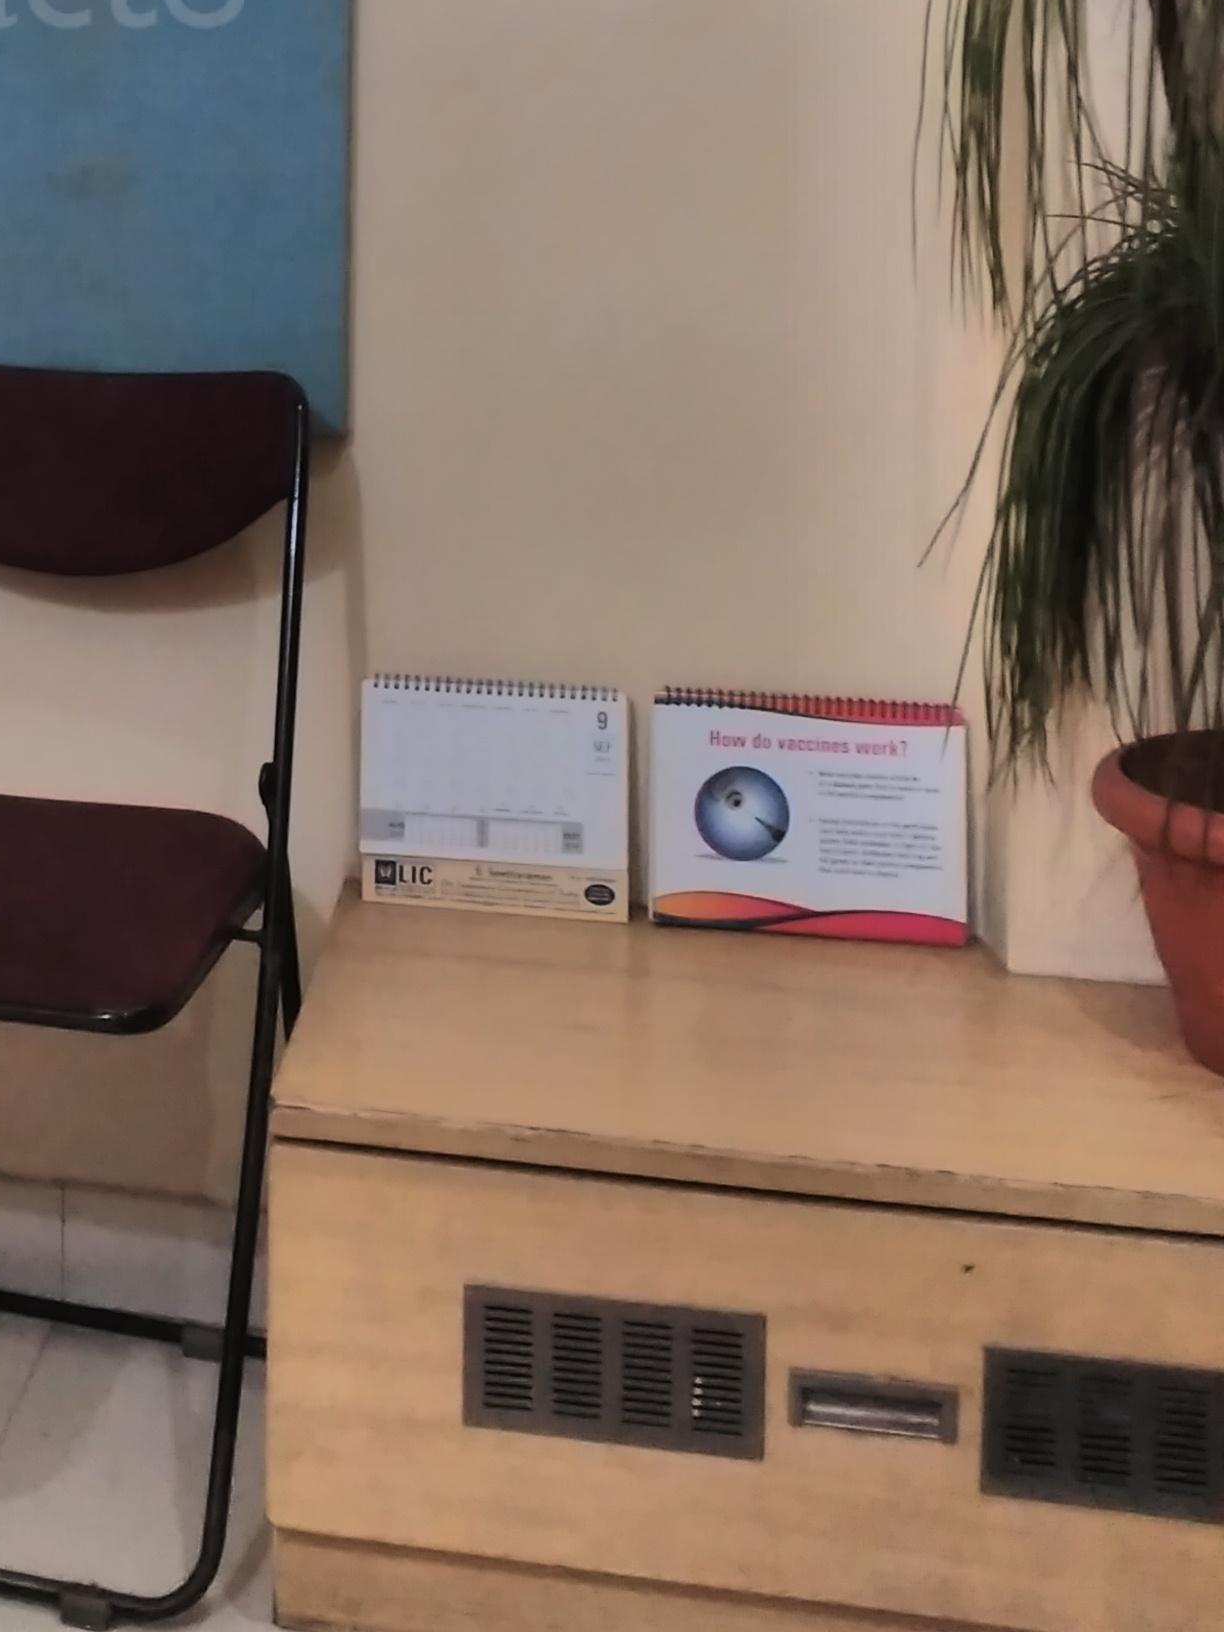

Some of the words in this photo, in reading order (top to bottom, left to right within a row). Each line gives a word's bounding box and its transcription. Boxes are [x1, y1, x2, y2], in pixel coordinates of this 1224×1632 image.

[596, 711, 608, 730] 9
[709, 730, 746, 748] How
[752, 733, 772, 749] do
[778, 735, 850, 754] vaccines
[855, 740, 907, 756] work?
[398, 864, 433, 886] LIC
